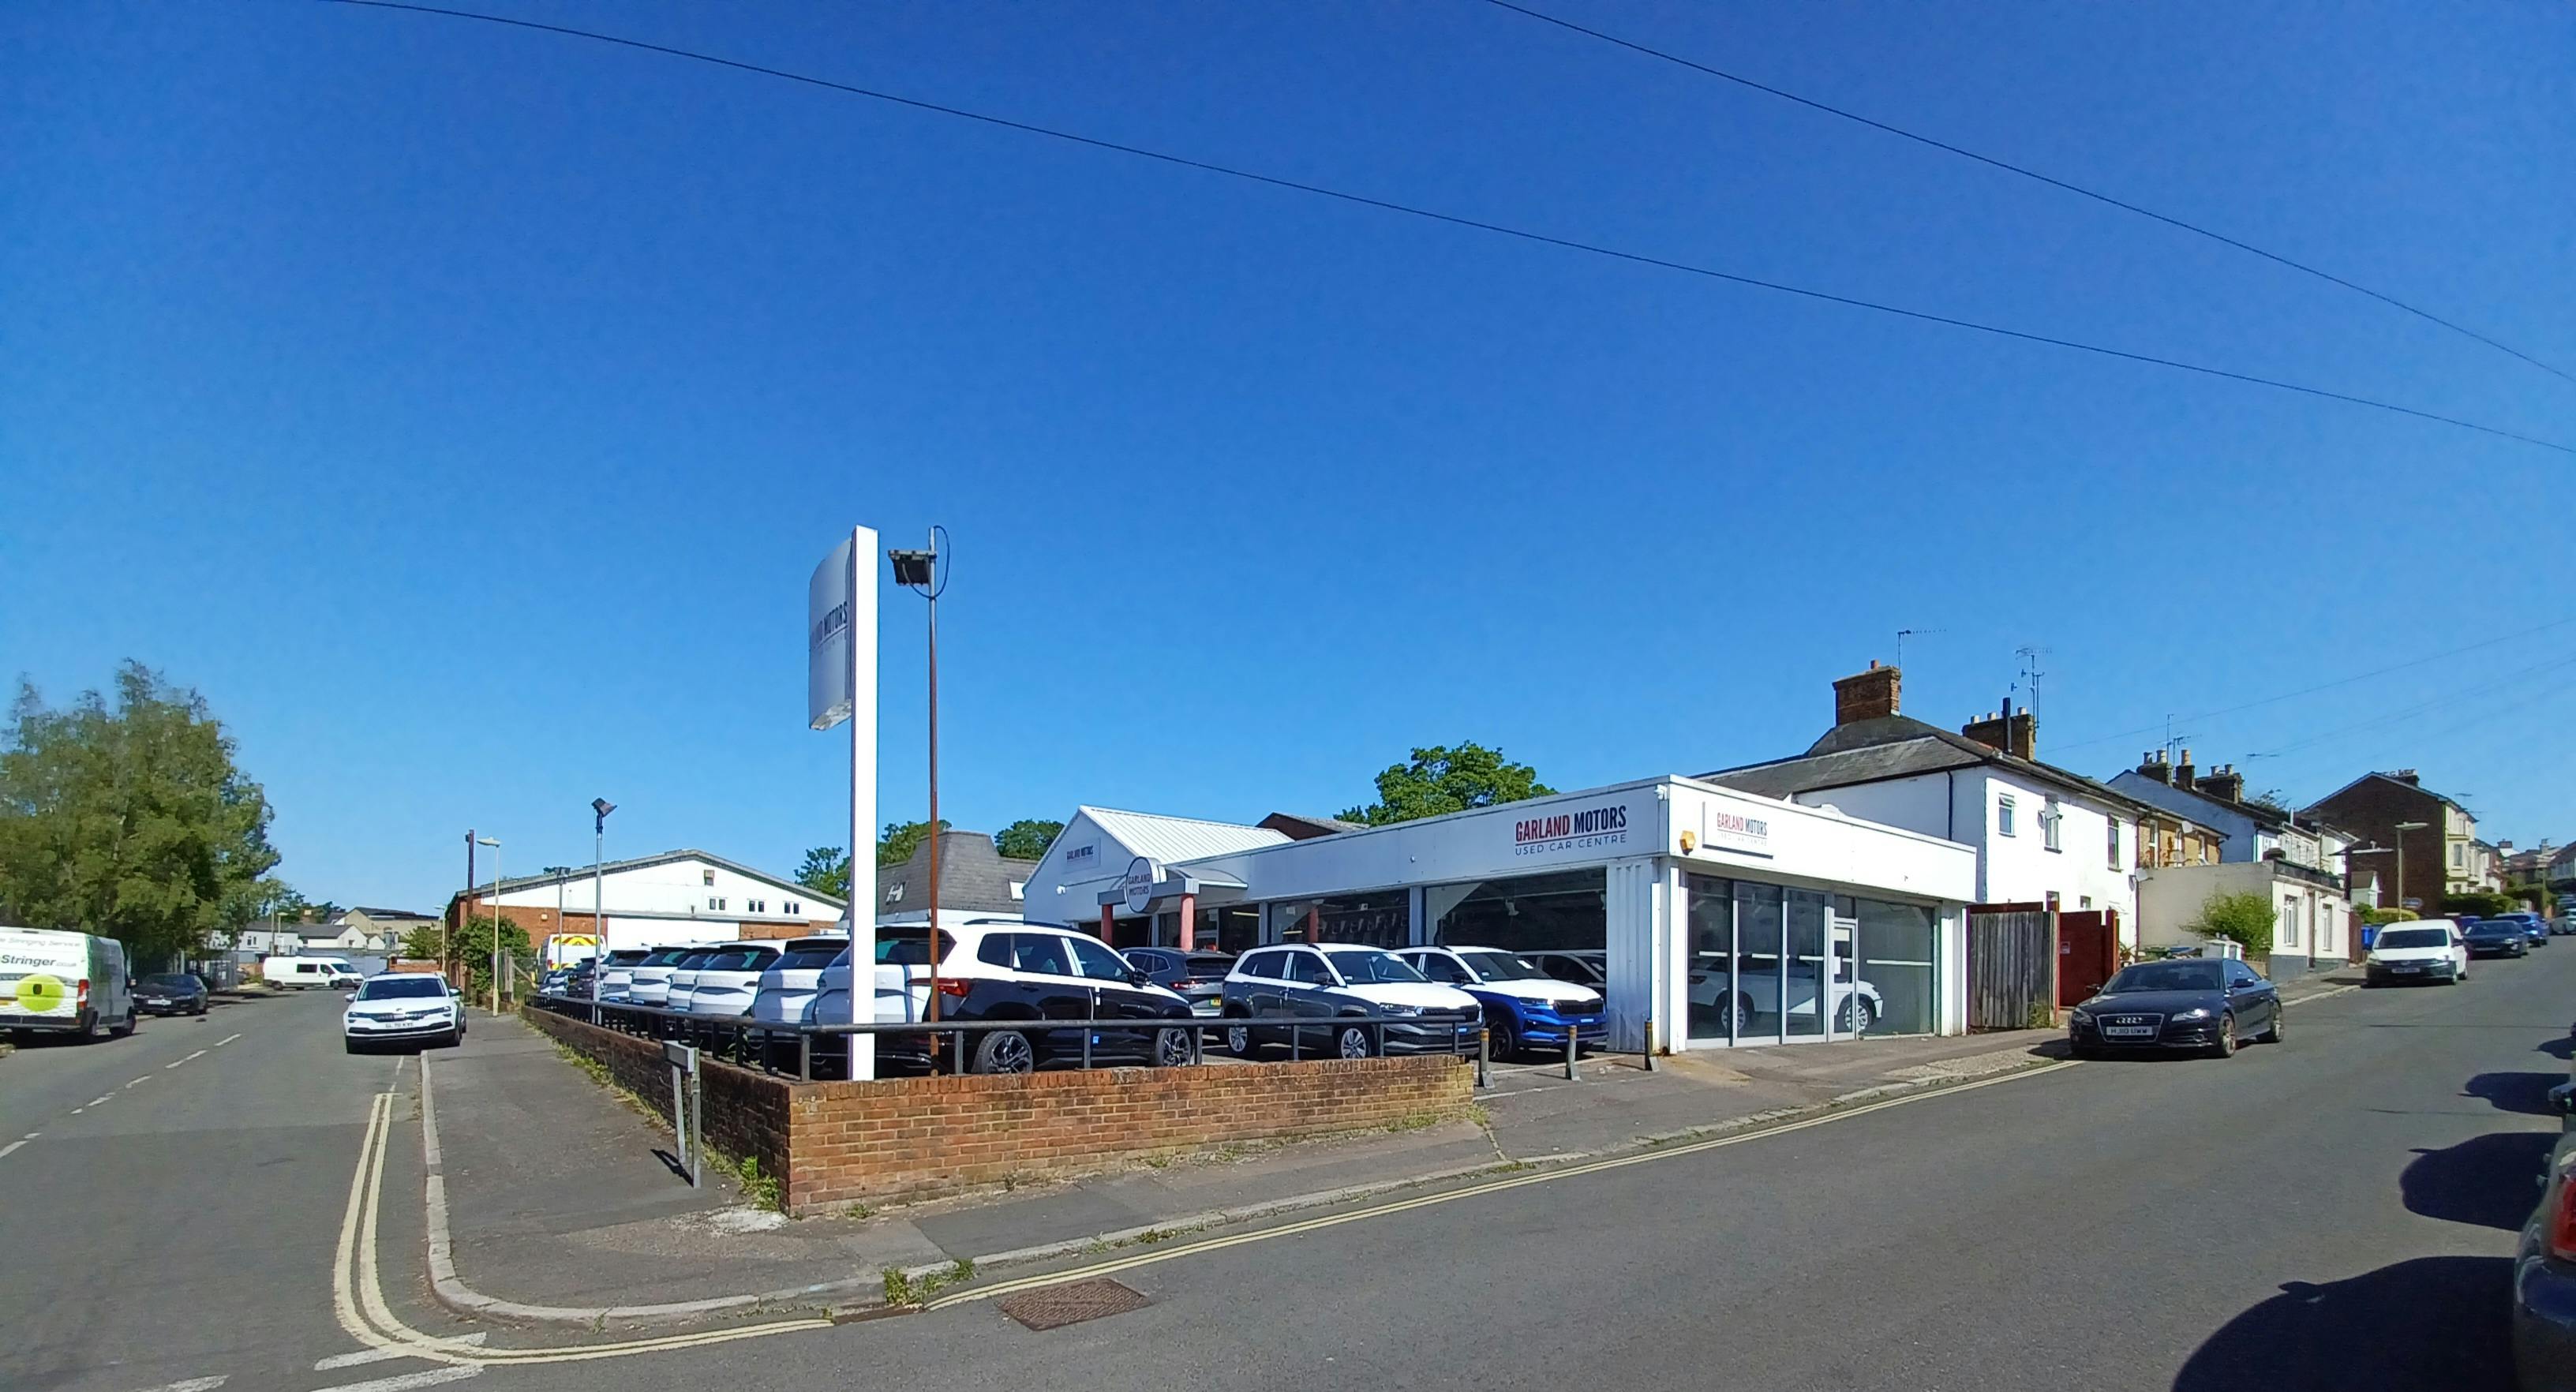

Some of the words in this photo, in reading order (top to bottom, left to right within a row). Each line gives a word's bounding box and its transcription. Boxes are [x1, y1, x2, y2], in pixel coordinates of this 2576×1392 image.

[823, 601, 848, 637] MOTORS
[1515, 814, 1571, 842] GARLAND
[1574, 805, 1627, 834] MOTORS
[1717, 812, 1743, 831] GARLAND
[1745, 818, 1767, 836] MOTORS
[1515, 844, 1544, 856] USED
[1549, 840, 1572, 851] CAR
[1578, 833, 1627, 848] CENTRE
[1129, 874, 1151, 884] GARLAND
[1129, 885, 1150, 896] MOTORS
